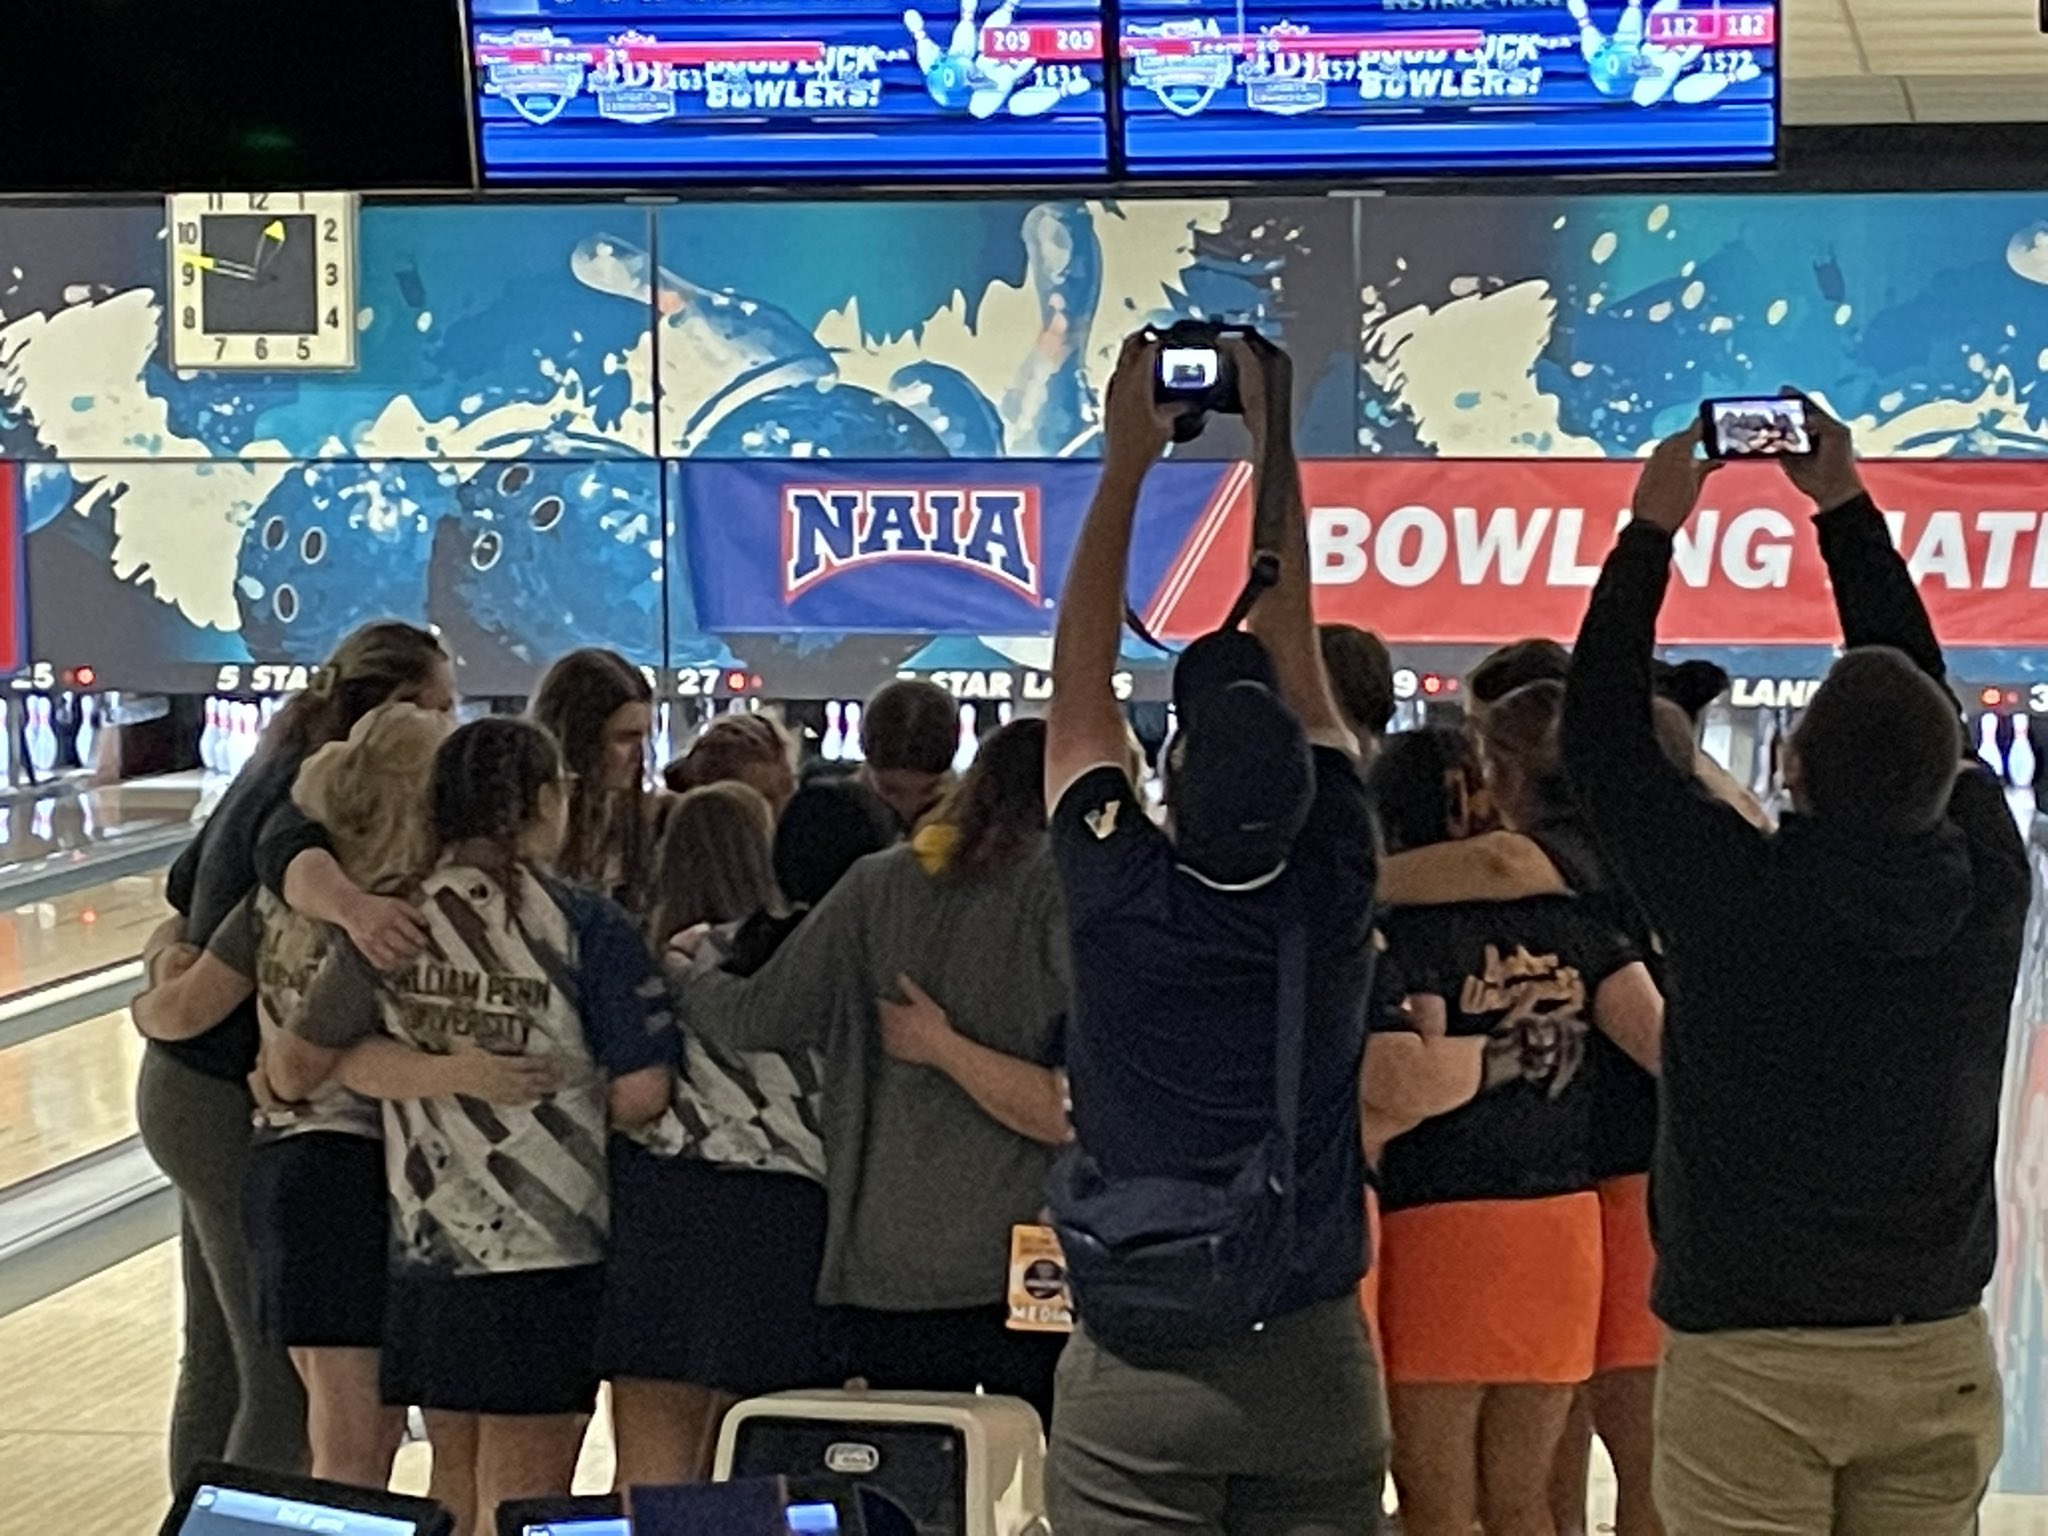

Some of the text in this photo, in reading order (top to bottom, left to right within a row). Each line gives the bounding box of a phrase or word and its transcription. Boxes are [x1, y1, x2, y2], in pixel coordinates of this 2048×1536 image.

[1661, 17, 1699, 37] 182
[992, 30, 1095, 52] 209 209
[249, 193, 268, 210] 12
[178, 222, 198, 244] 10
[324, 218, 338, 242] 2
[182, 262, 195, 286] 9
[325, 263, 338, 286] 3
[183, 306, 195, 330] 8
[325, 307, 339, 329] 4
[214, 337, 227, 360] 7
[255, 337, 268, 360] 6
[296, 337, 310, 360] 5
[786, 489, 1038, 594] NAIA
[1308, 506, 1796, 590] BOWLNG
[250, 664, 320, 691] STA
[677, 667, 721, 695] 27
[1022, 670, 1133, 700] LAS
